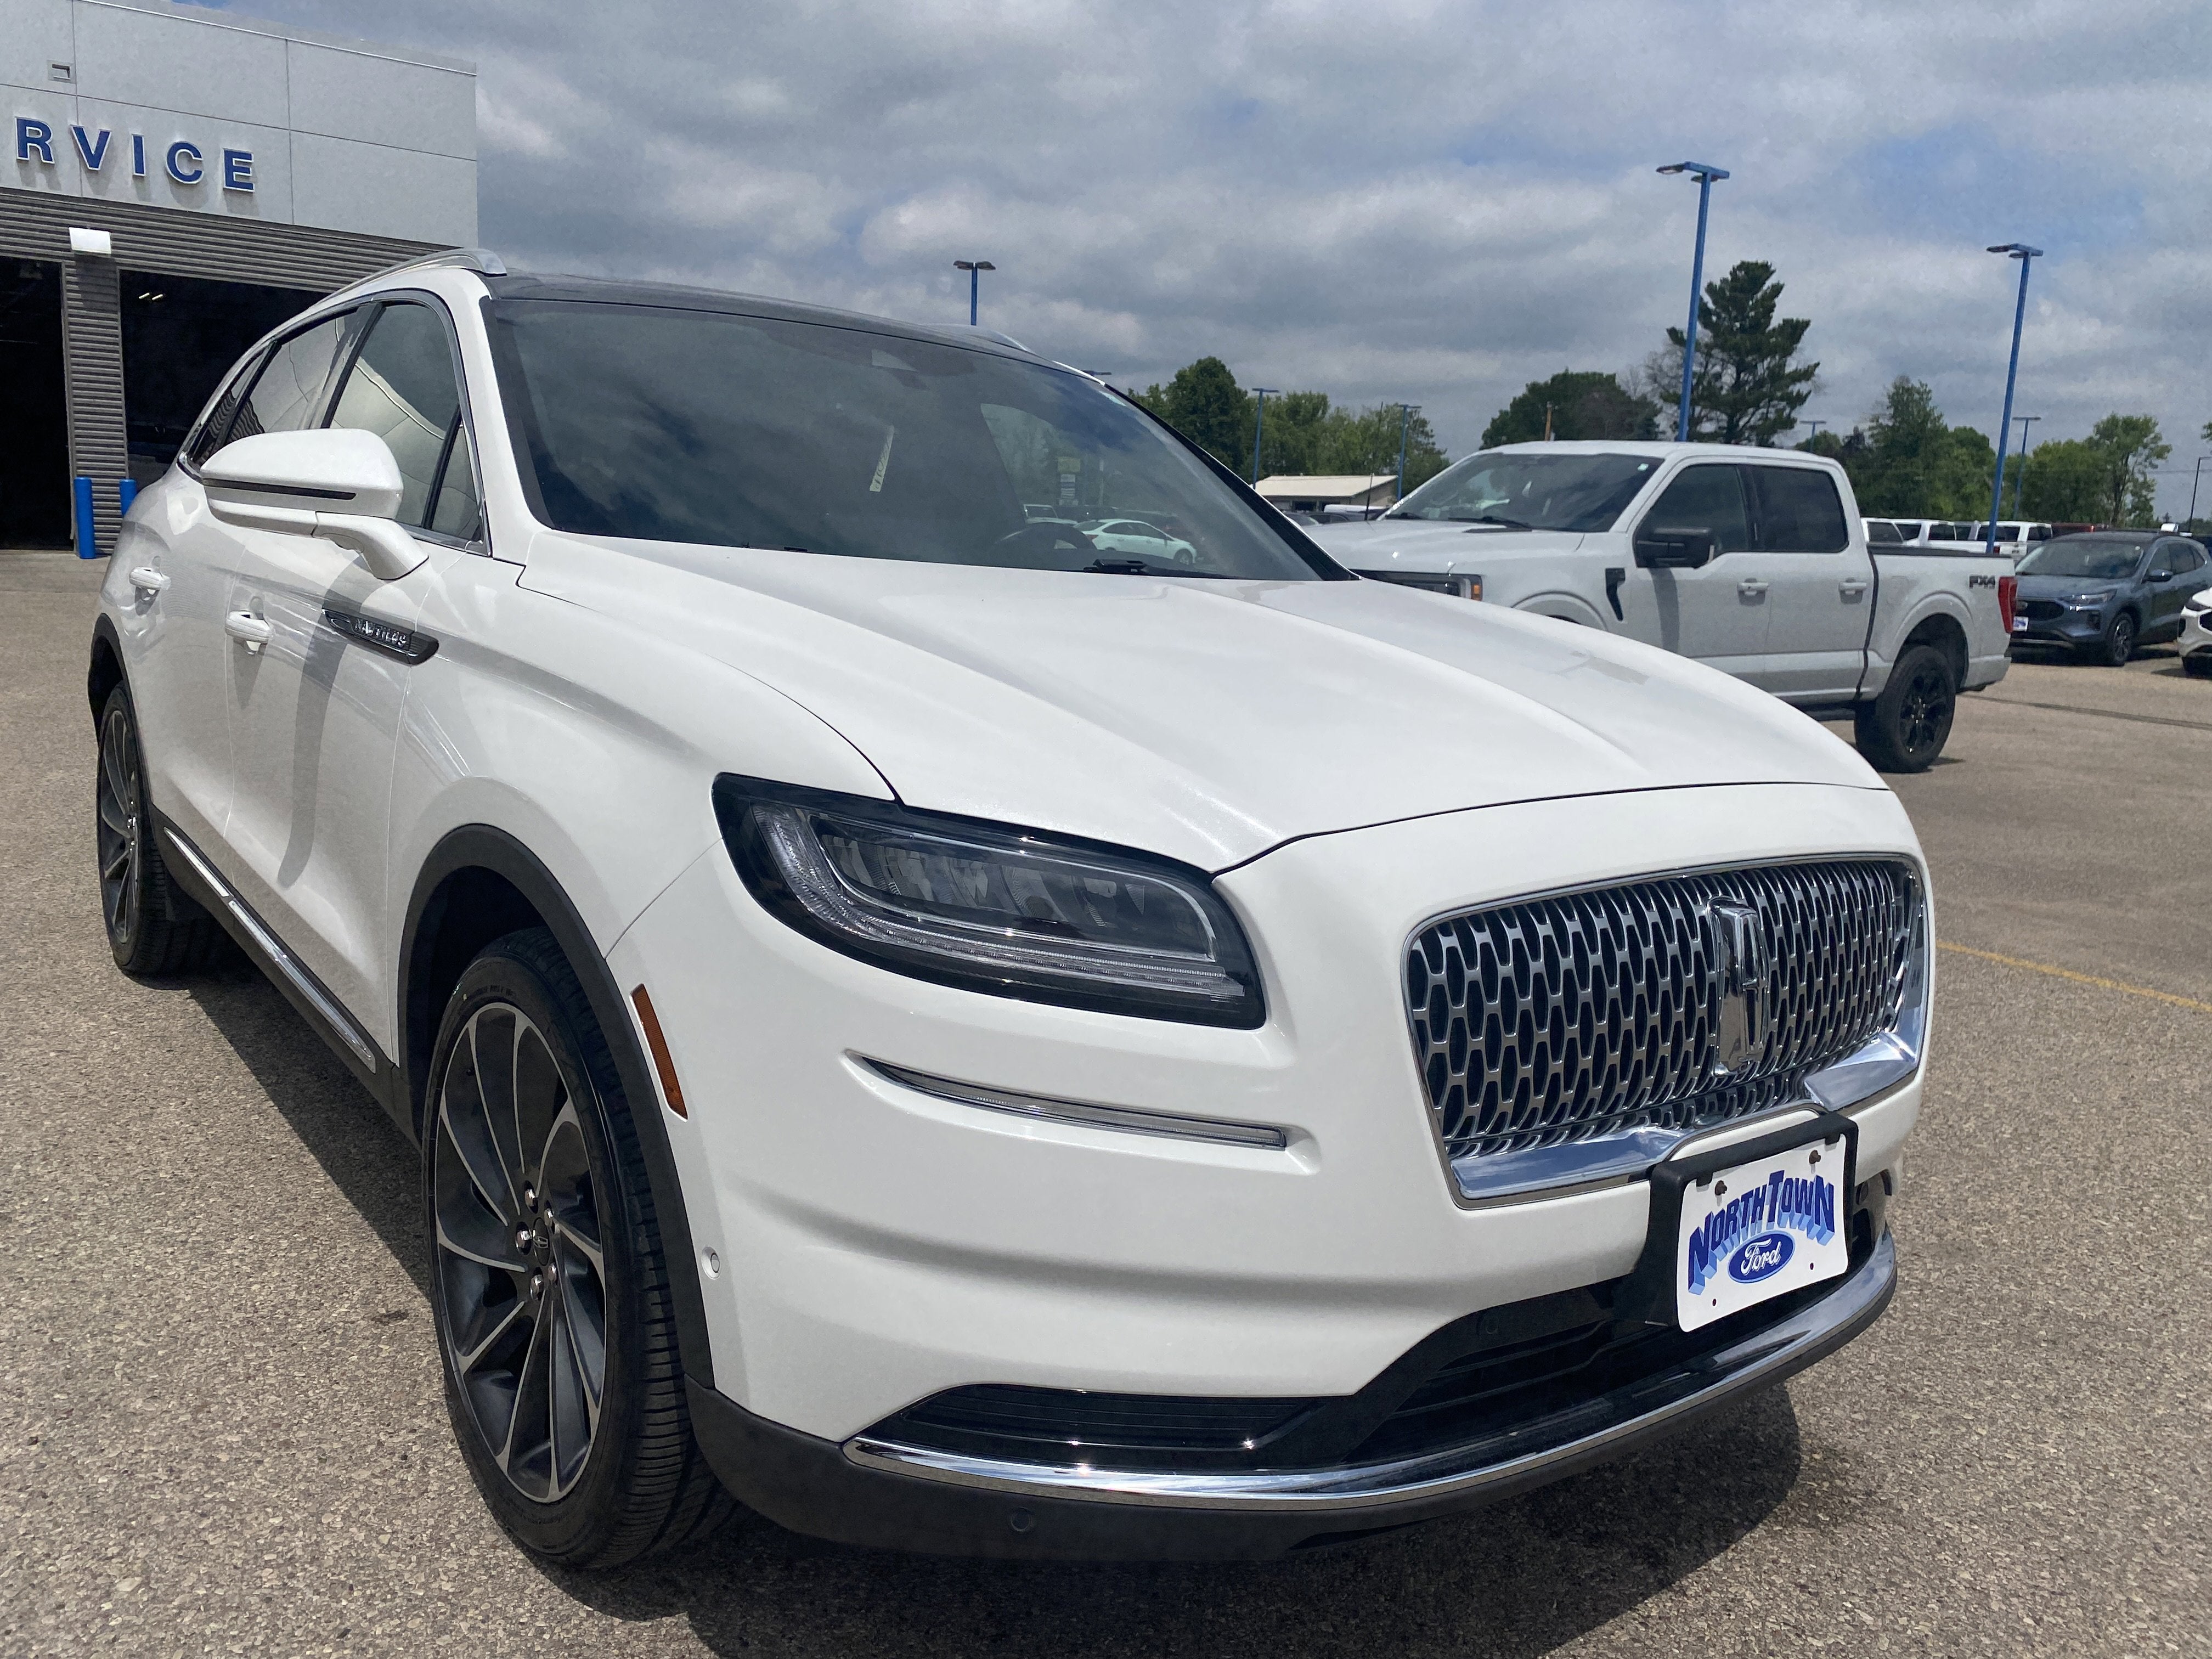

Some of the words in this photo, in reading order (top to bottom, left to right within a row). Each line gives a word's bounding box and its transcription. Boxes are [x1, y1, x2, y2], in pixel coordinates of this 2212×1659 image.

[14, 116, 255, 192] RVICE
[1969, 574, 1996, 589] FX4
[1740, 1238, 1782, 1276] Ford
